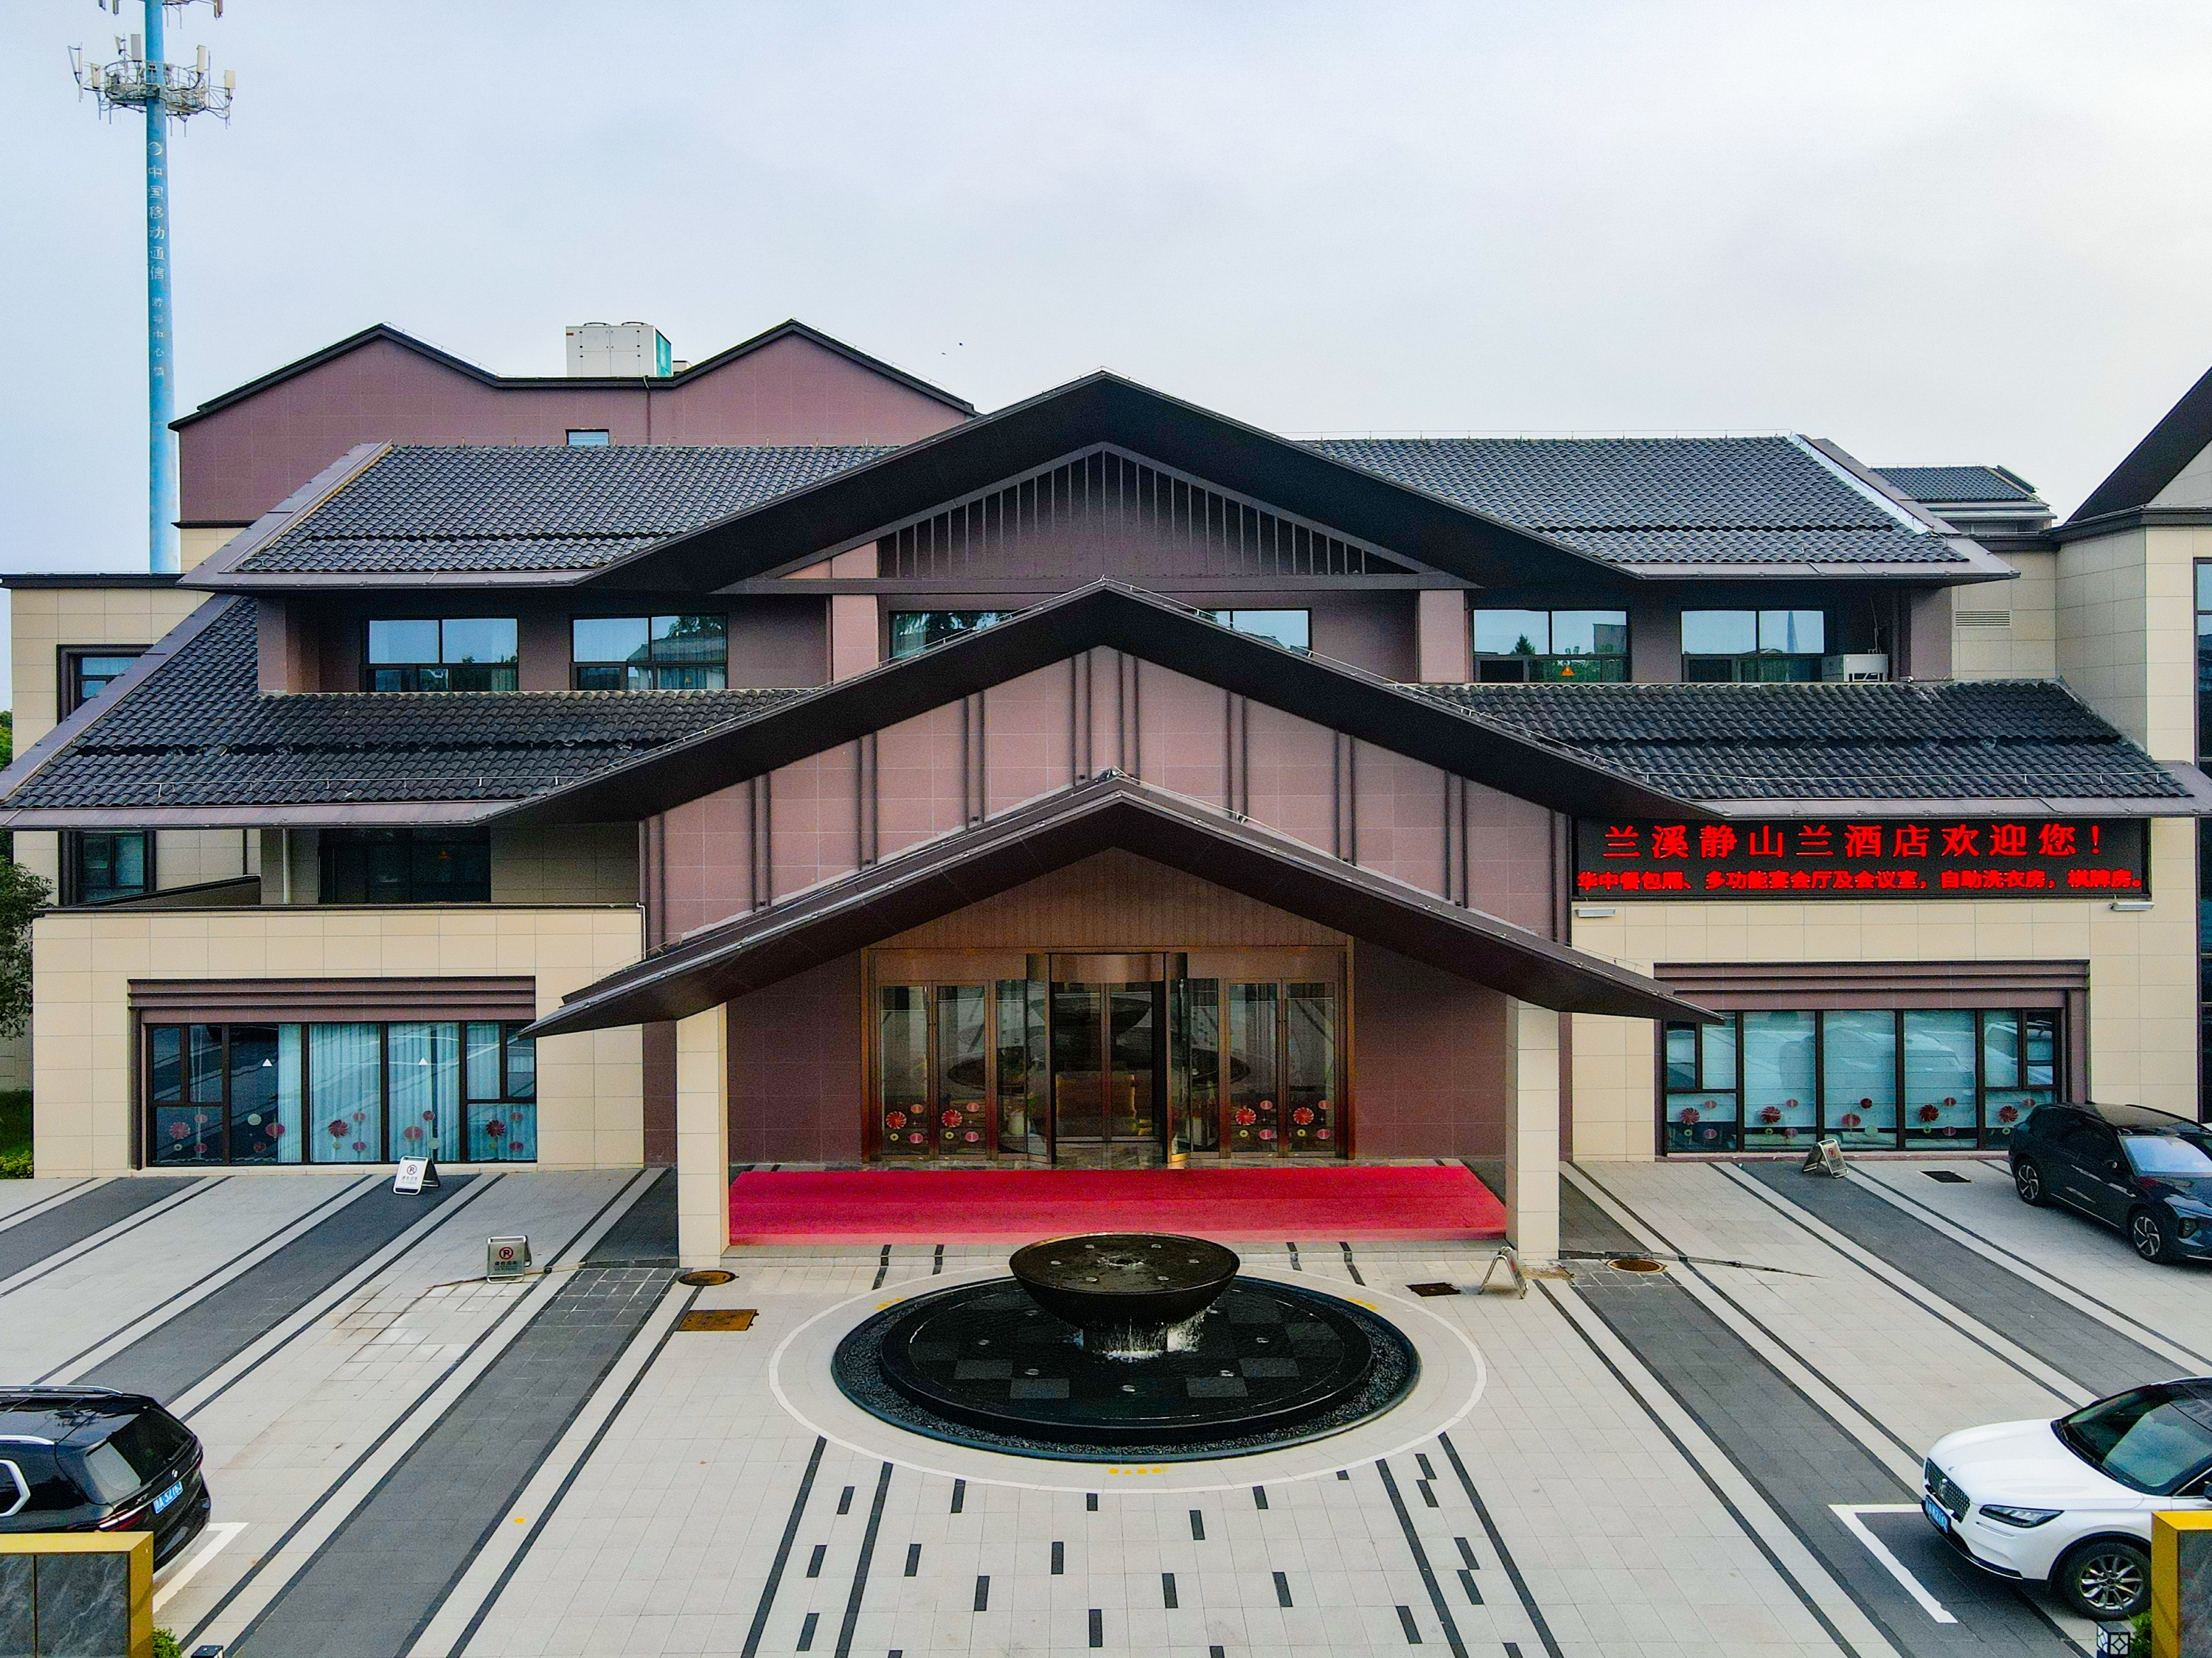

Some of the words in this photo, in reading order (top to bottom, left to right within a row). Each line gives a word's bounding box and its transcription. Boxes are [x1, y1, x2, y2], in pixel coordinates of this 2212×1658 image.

[148, 165, 164, 280] 中国移动通信
